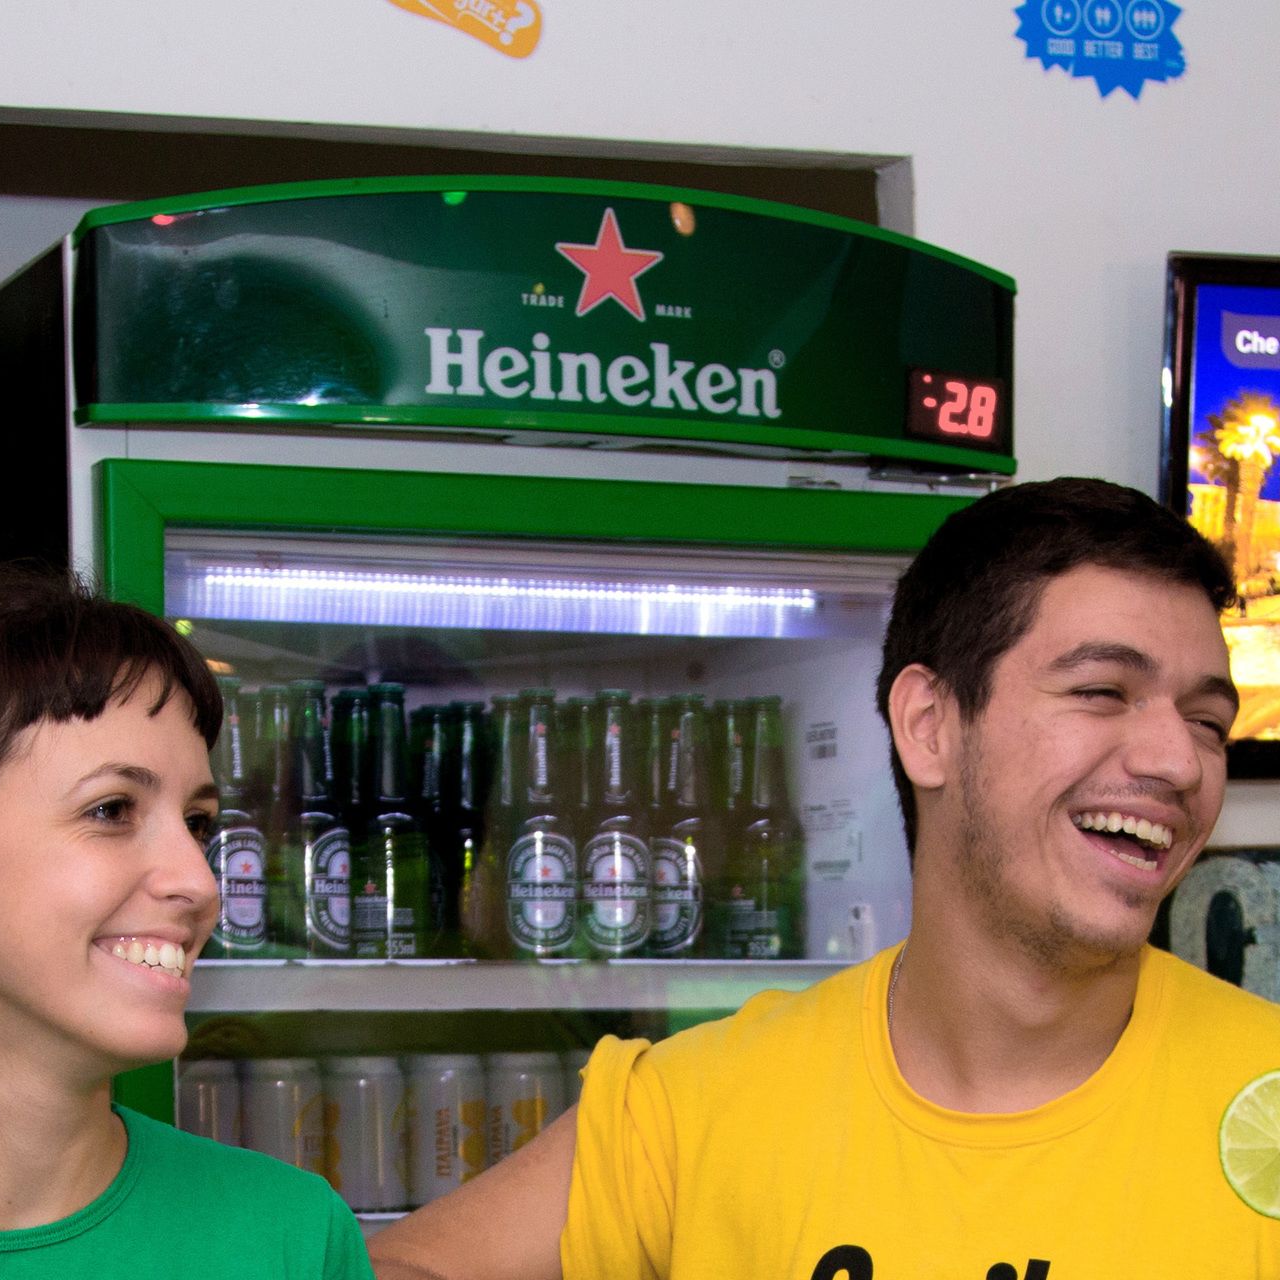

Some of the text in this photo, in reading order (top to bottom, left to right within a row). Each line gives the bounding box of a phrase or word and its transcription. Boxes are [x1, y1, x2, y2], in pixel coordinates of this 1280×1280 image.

[521, 293, 692, 319] TRADE MARK
[1235, 330, 1279, 354] Che
[424, 327, 781, 419] Heineken
